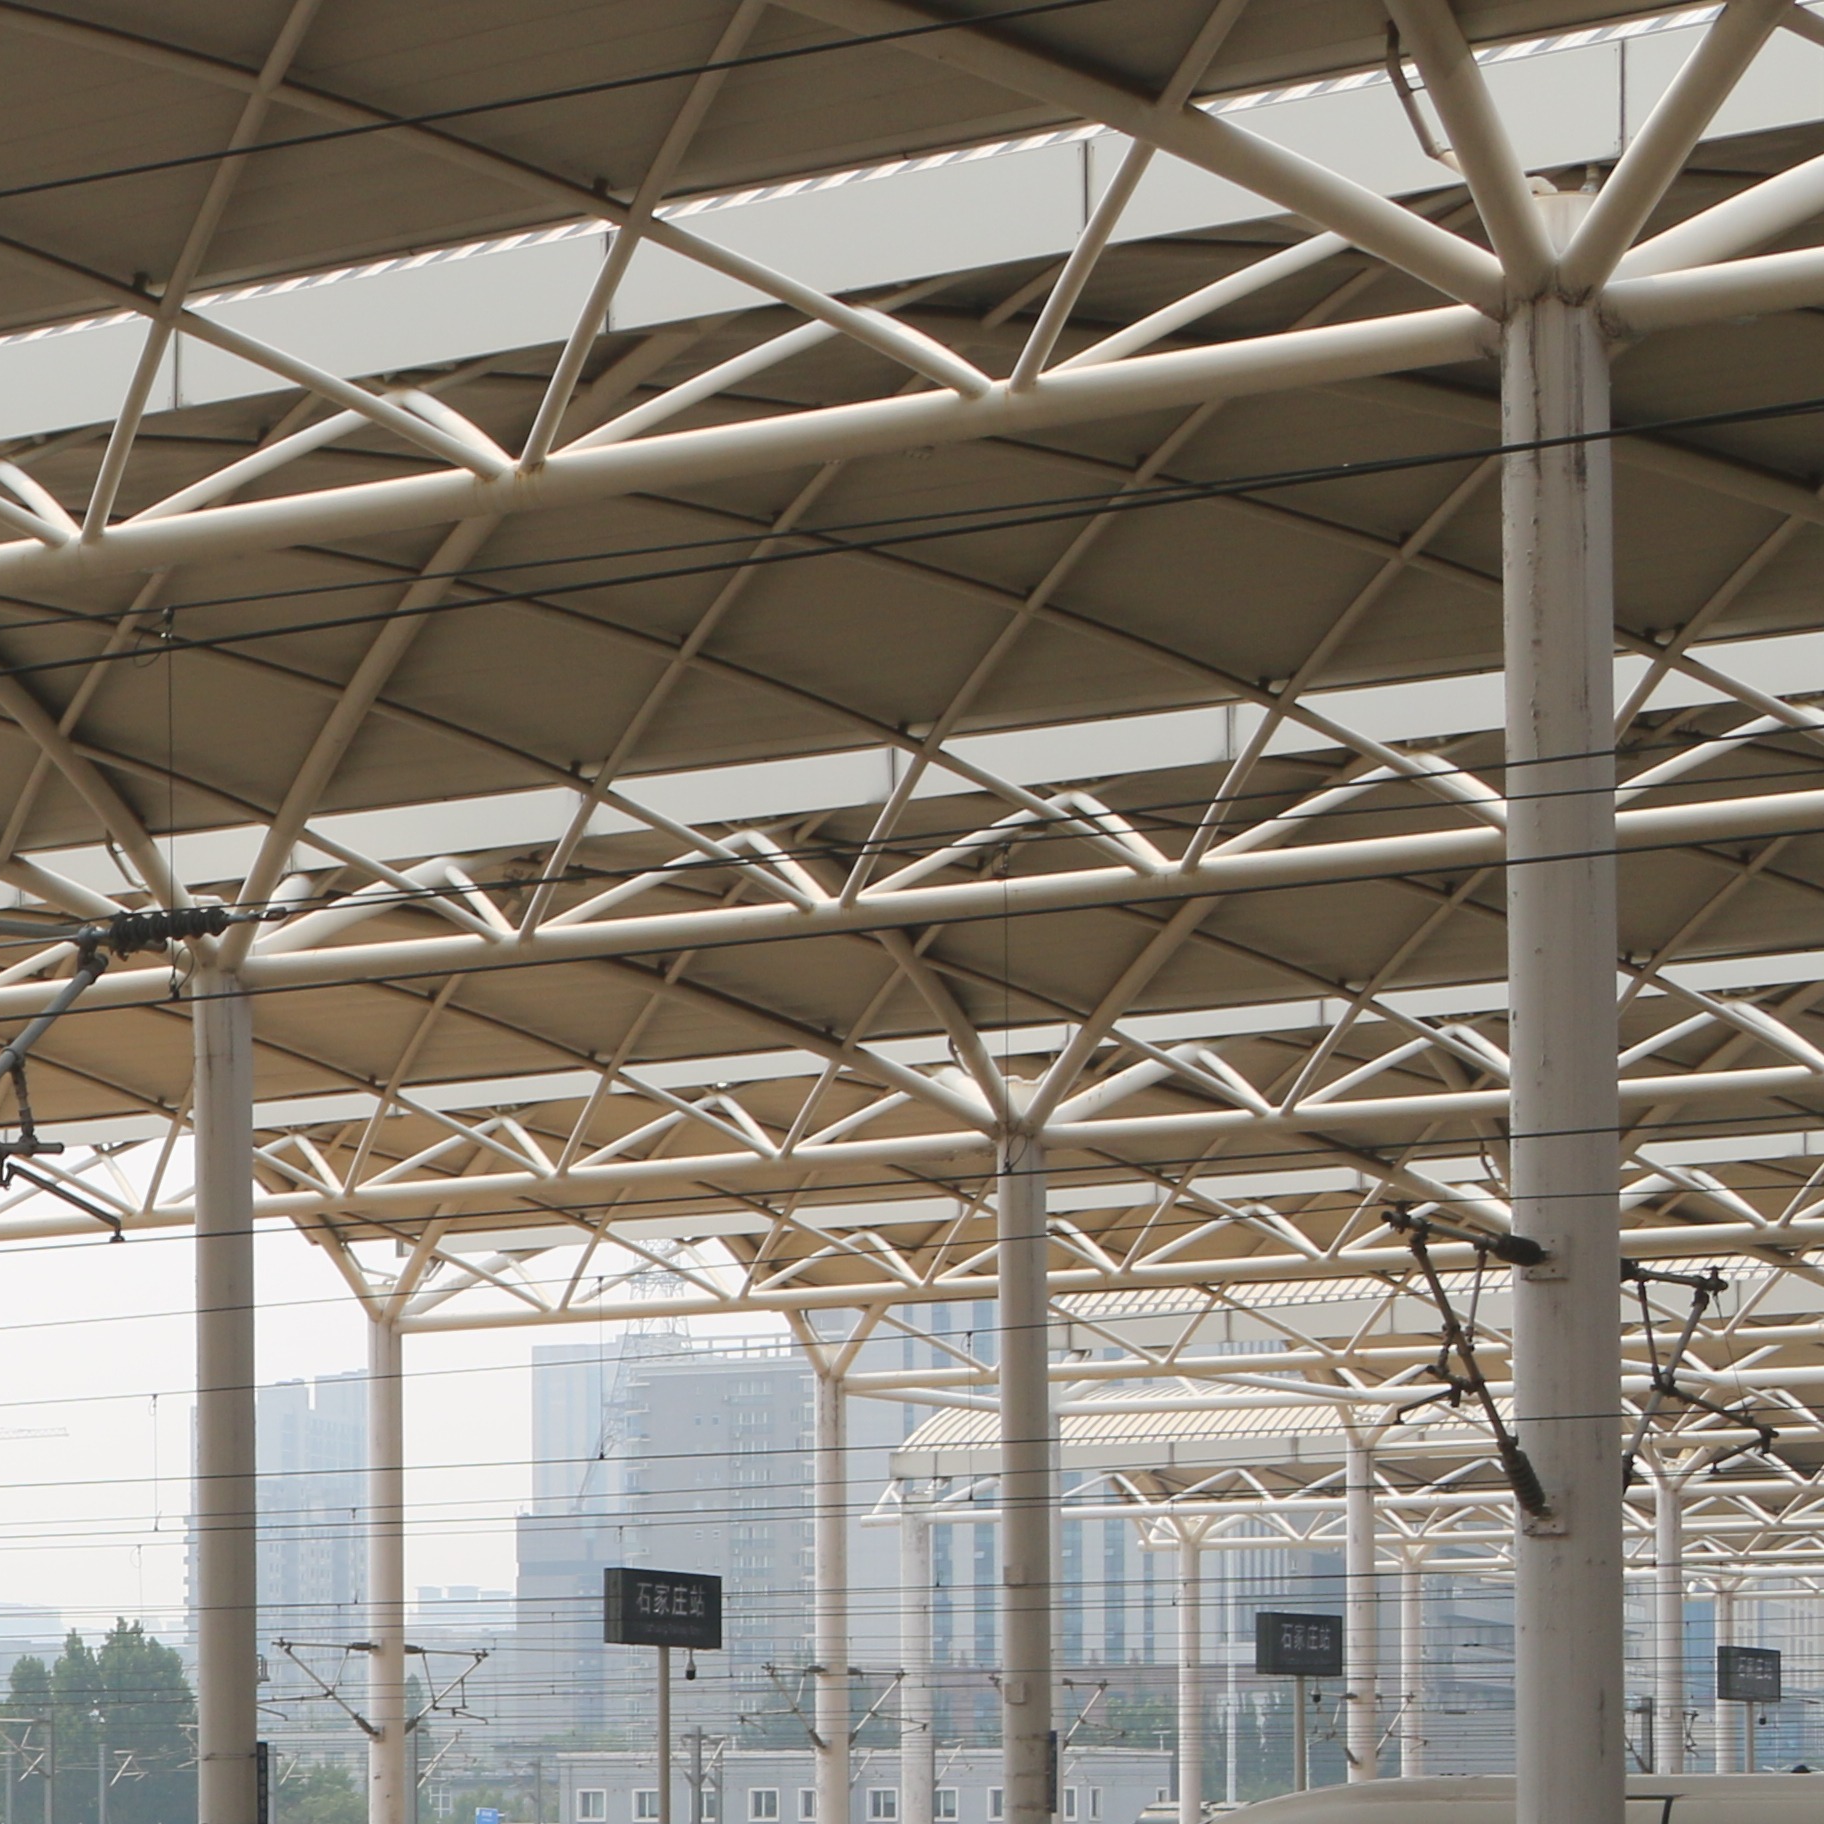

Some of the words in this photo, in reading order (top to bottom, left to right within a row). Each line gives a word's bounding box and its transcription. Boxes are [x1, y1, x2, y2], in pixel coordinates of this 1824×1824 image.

[635, 1582, 705, 1618] 石家庄站
[1281, 1624, 1331, 1651] 石家庄站
